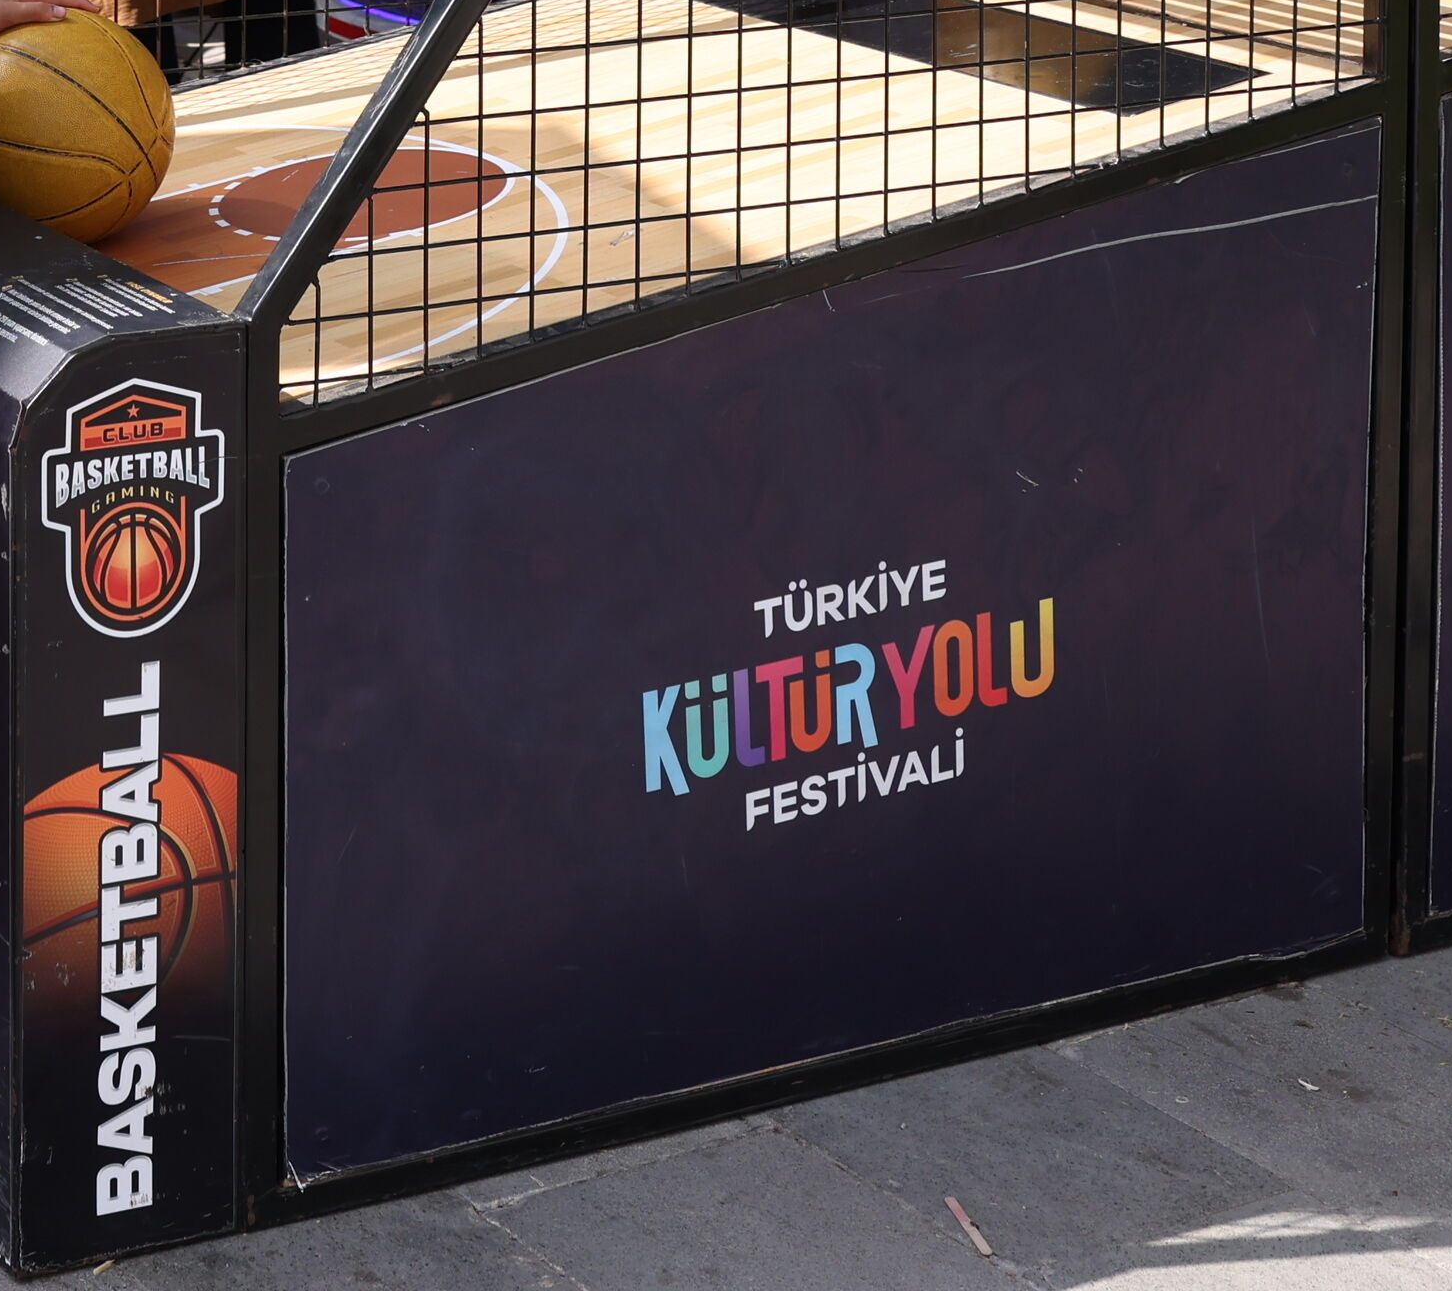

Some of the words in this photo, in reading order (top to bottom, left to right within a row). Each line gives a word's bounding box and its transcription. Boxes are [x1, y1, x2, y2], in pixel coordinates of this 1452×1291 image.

[102, 422, 164, 444] CLUB
[56, 446, 210, 509] BASKETBALL
[91, 485, 175, 514] GAMING
[754, 559, 947, 639] TÜRKİYE
[642, 642, 879, 797] KÜLTÜR
[881, 597, 1055, 730] YOLU
[745, 727, 965, 832] FESTİVALİ
[96, 660, 161, 1217] BASKETBALL
